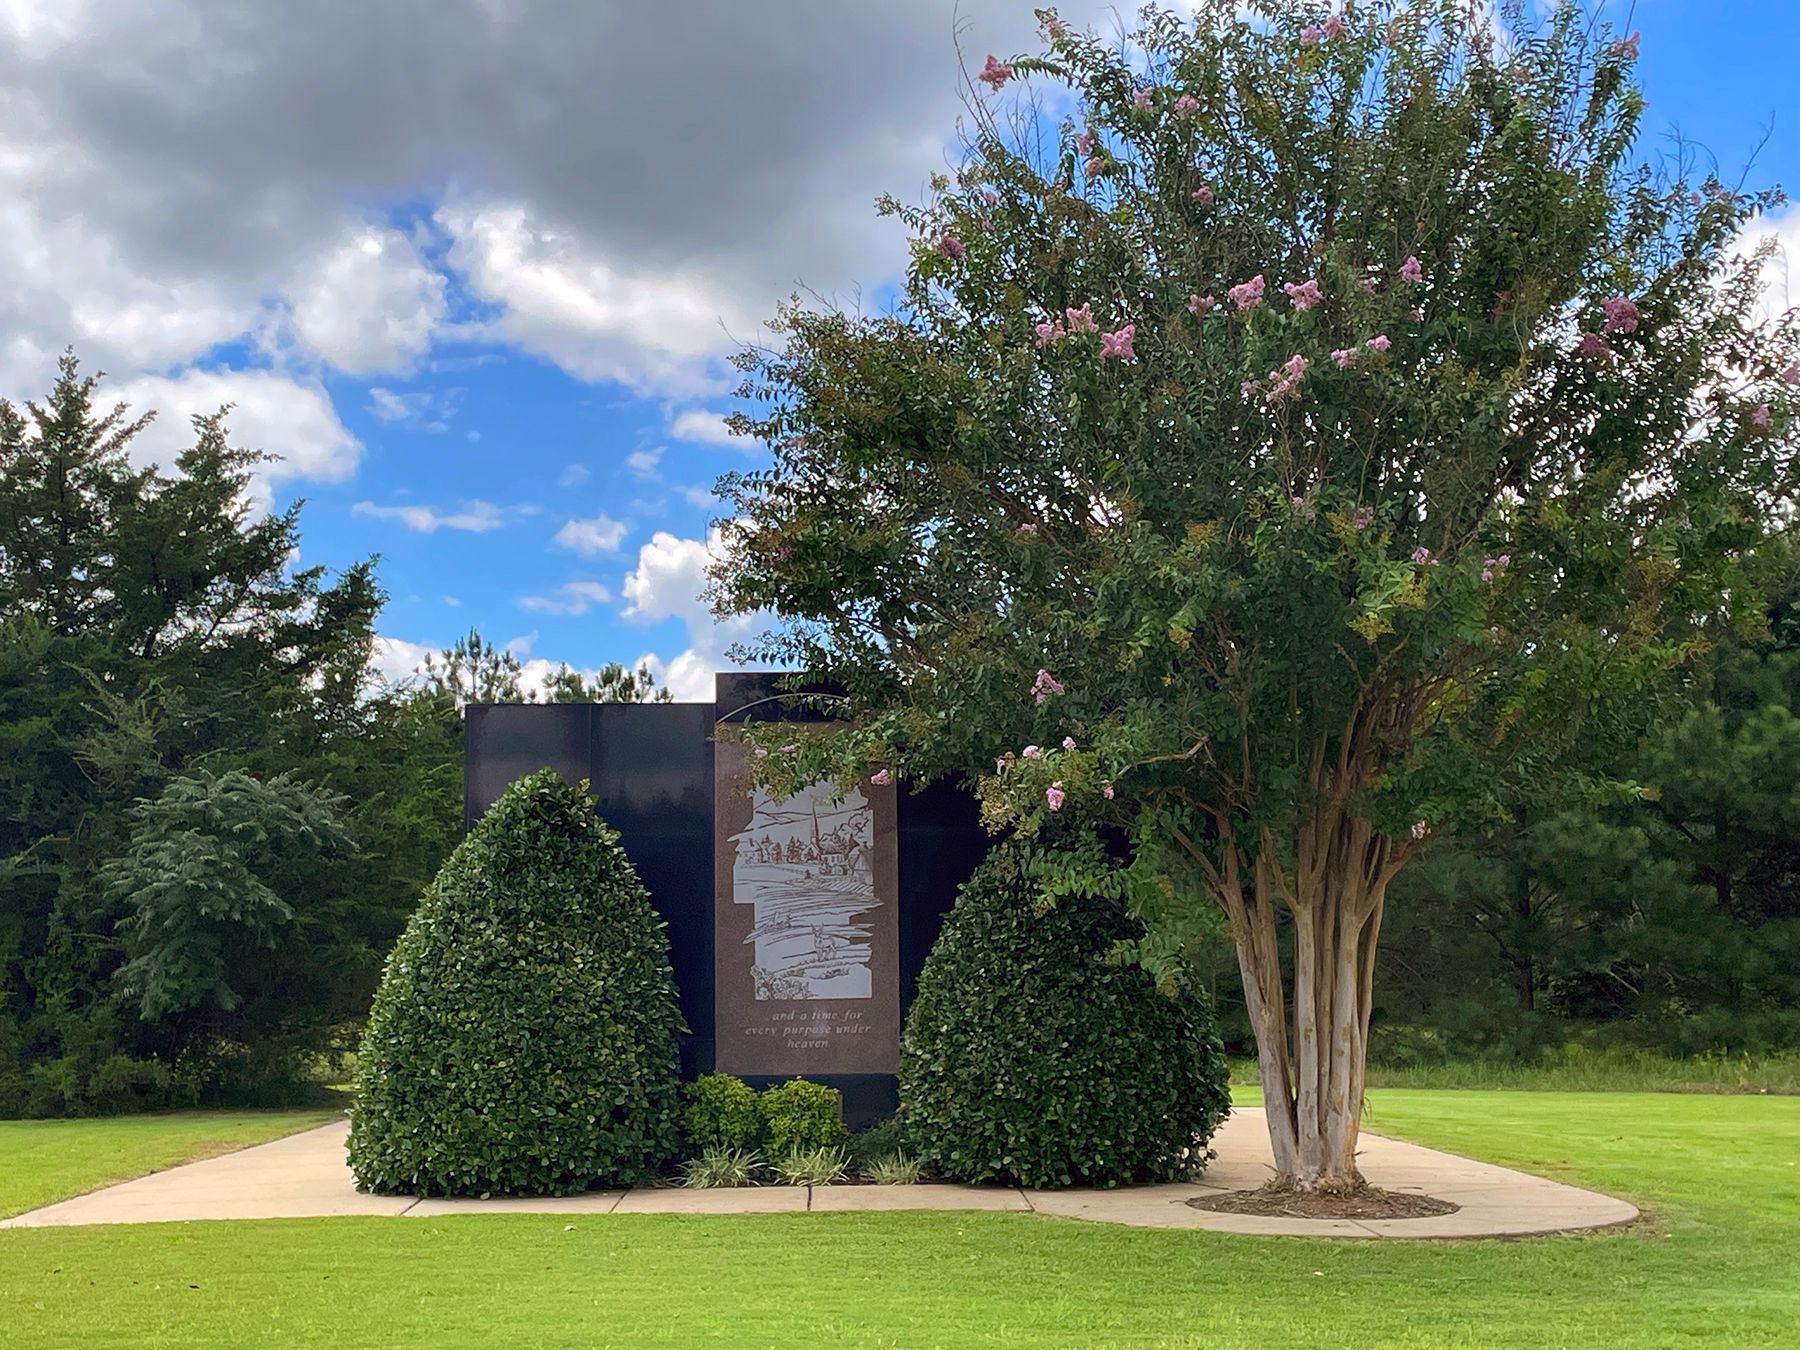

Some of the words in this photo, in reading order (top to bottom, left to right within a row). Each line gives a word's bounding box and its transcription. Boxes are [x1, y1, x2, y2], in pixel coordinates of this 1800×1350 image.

[772, 1010, 794, 1021] and
[800, 1013, 807, 1021] a
[811, 1011, 838, 1021] time
[842, 1010, 863, 1022] for
[745, 1027, 777, 1036] every
[782, 1025, 832, 1037] purpose
[836, 1023, 872, 1034] under
